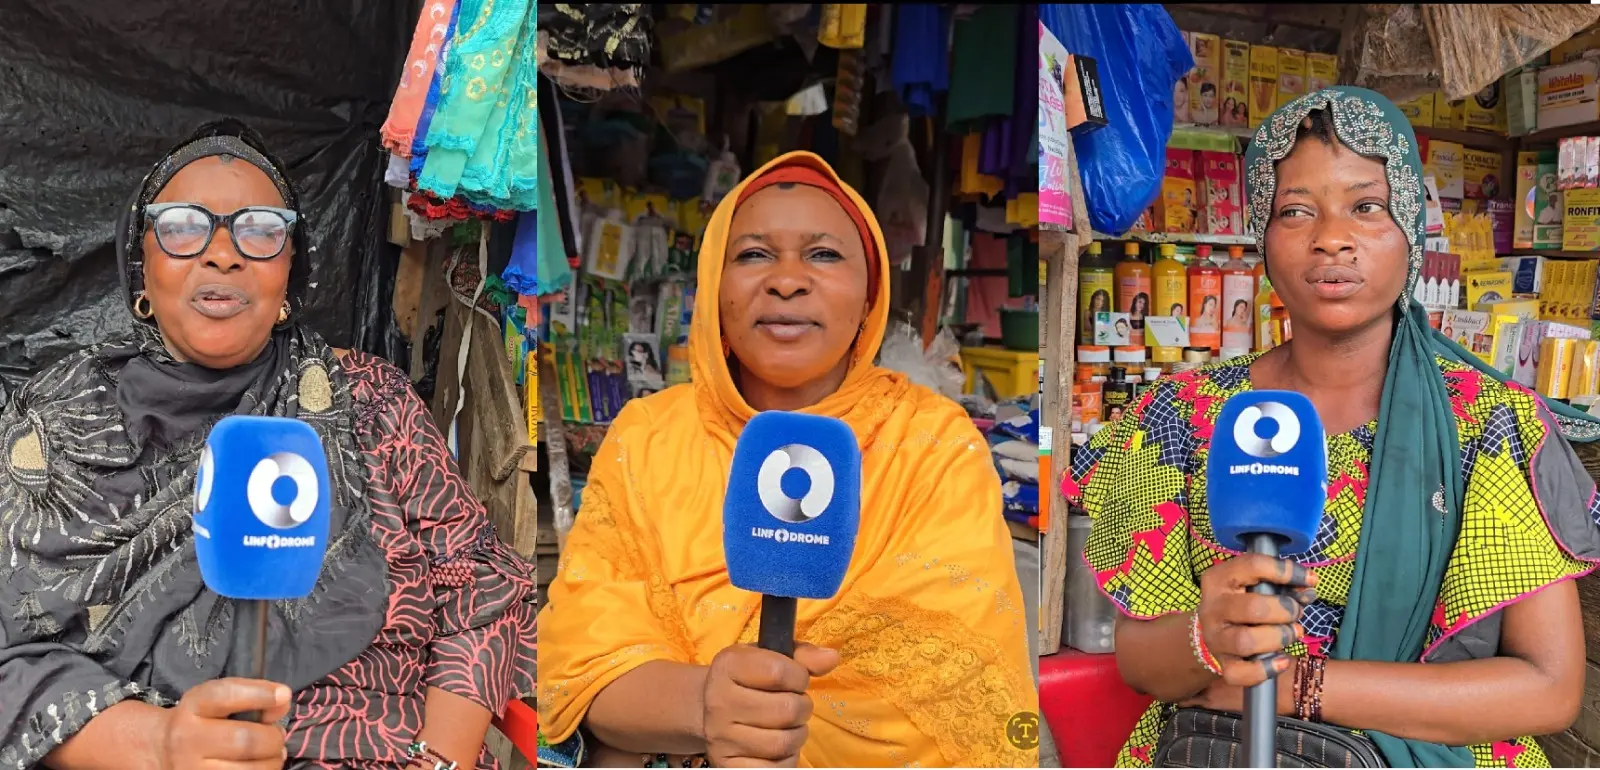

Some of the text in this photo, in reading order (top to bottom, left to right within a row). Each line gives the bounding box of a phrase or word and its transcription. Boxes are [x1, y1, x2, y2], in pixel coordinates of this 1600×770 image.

[1230, 462, 1300, 476] LINFODROME
[243, 534, 316, 549] LINFODROME
[752, 527, 830, 545] LINFODROME
